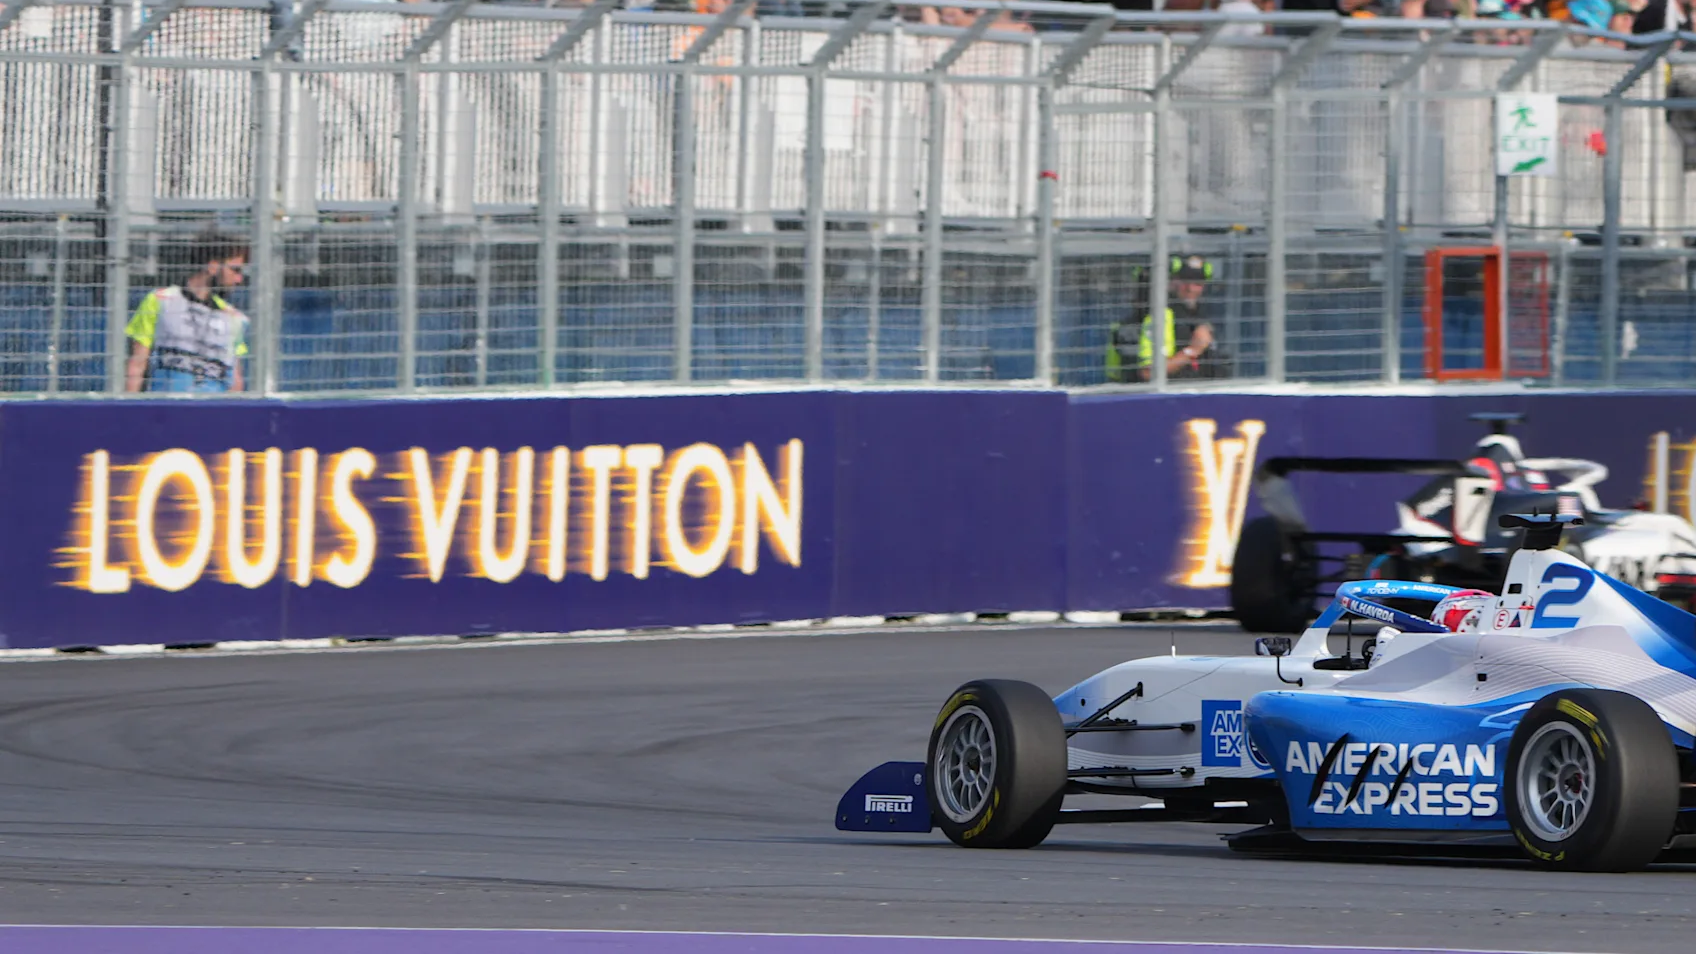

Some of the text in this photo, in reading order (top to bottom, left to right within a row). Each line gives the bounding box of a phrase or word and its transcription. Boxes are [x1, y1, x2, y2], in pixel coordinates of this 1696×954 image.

[1502, 136, 1550, 153] EXIT
[86, 439, 804, 593] LOUIS VUITTON
[1530, 562, 1596, 629] 2
[1210, 710, 1242, 736] AM
[1215, 734, 1242, 757] EX
[1285, 740, 1496, 777] AMERICAN
[864, 794, 914, 813] PIRELLI
[1314, 781, 1499, 817] EXPRESS
